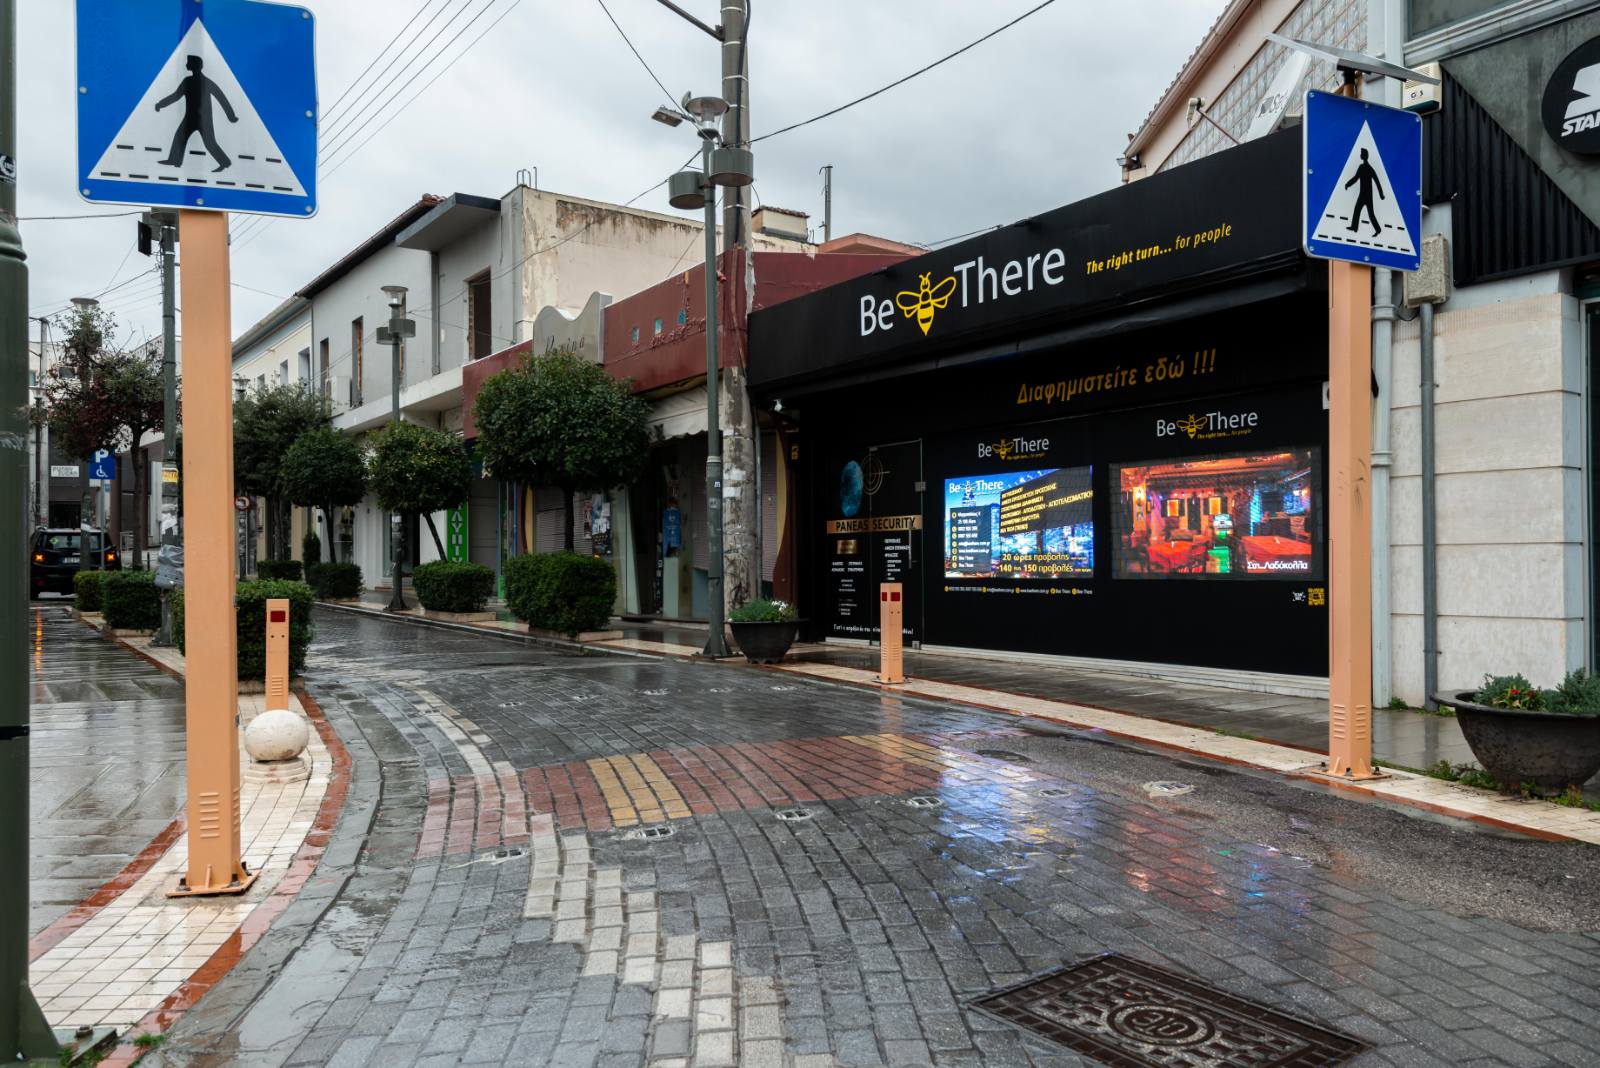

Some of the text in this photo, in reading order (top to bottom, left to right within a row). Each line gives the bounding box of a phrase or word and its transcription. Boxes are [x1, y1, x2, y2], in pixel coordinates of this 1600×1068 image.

[1087, 223, 1232, 275] The right turn... for people
[860, 247, 1067, 337] Be There
[1017, 348, 1217, 404] Διαφημιστείτε εδώ !!!
[1156, 411, 1258, 437] Be There
[95, 448, 109, 463] P
[978, 443, 992, 458] Be
[1012, 437, 1050, 453] There
[949, 480, 1004, 493] Be There
[836, 517, 916, 532] PANEAS SECURITY
[1002, 553, 1011, 561] 20
[1013, 553, 1032, 563] ώρες
[1023, 564, 1037, 572] 150
